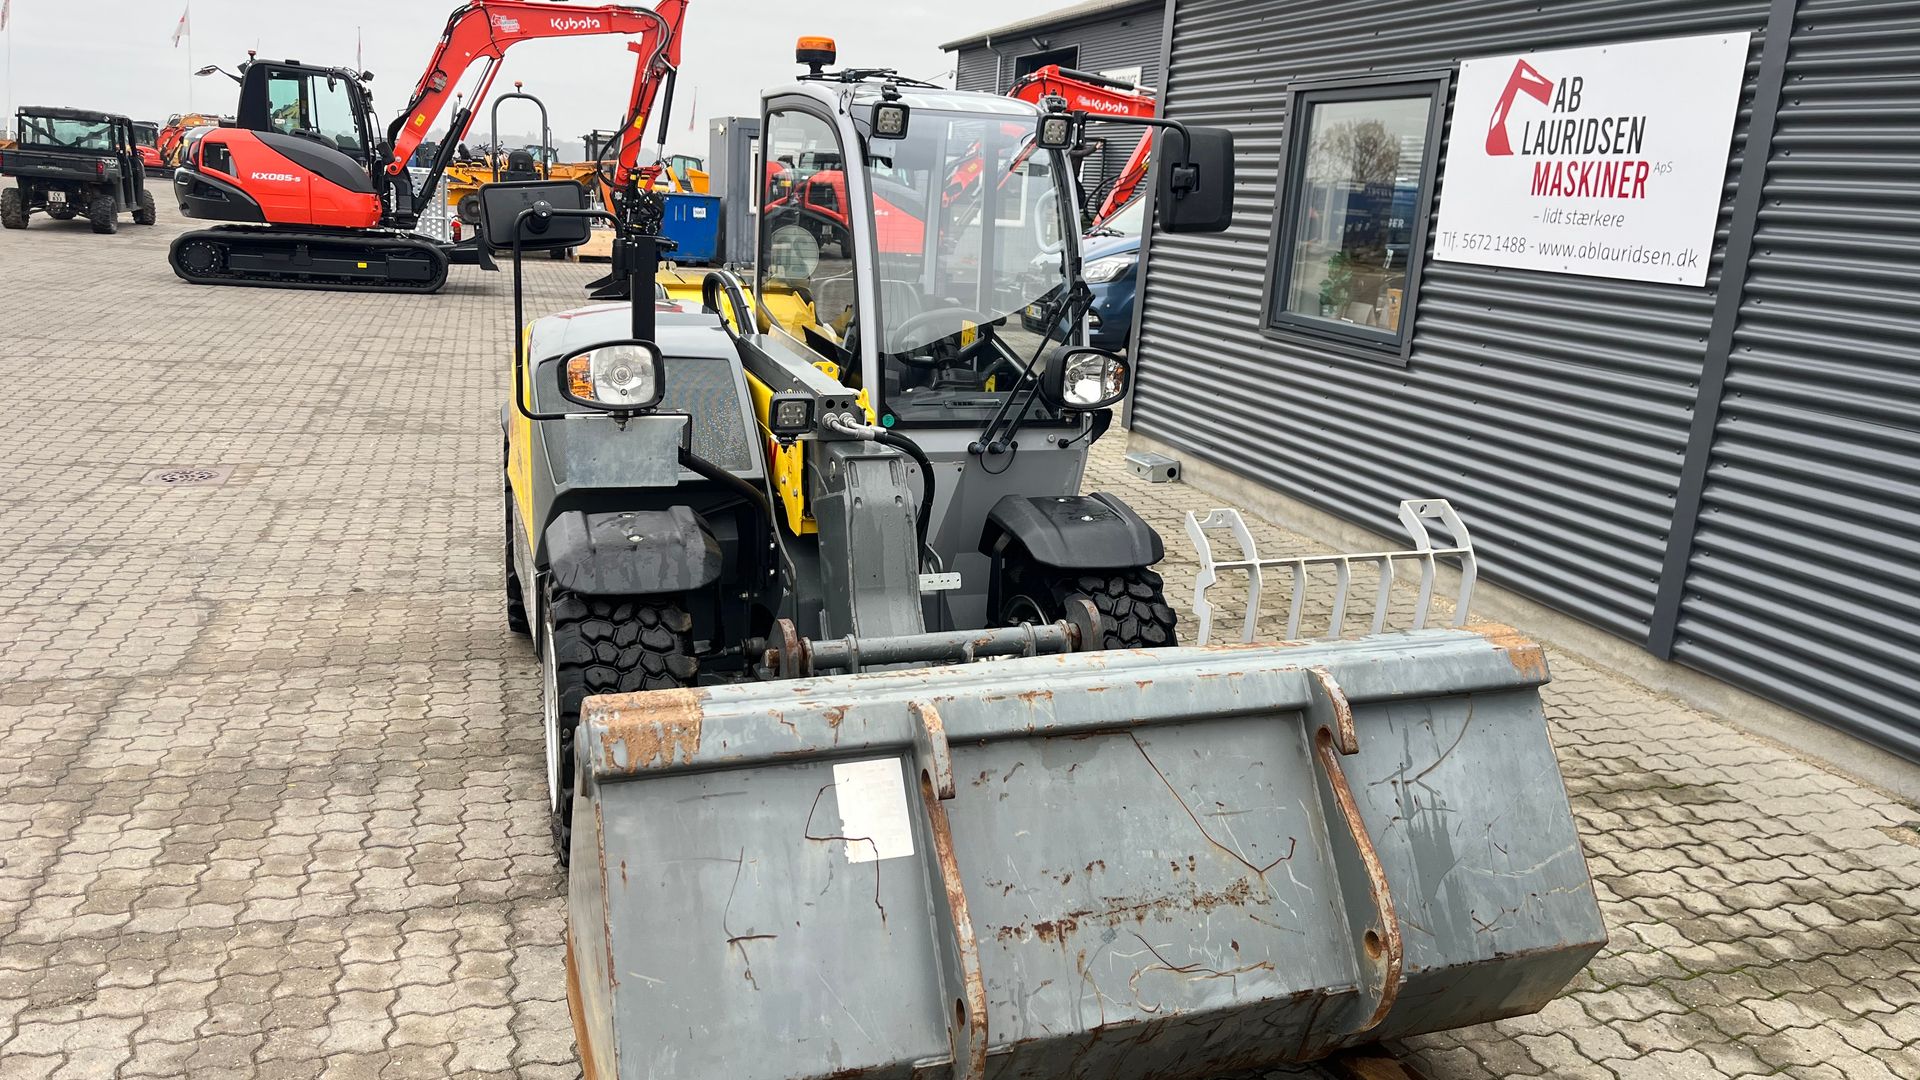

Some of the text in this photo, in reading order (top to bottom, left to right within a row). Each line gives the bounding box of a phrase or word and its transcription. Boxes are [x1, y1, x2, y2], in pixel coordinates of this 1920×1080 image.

[550, 16, 601, 31] Kubota
[1091, 99, 1129, 115] Kubota
[1552, 76, 1584, 114] AB
[1521, 115, 1647, 156] LAURIDSEN
[1530, 160, 1673, 199] MASKINER ApS
[1542, 207, 1564, 225] lidt
[1565, 209, 1625, 228] stærkere
[1442, 231, 1459, 252] Tlf.
[1538, 241, 1699, 269] www.ablauridsen.dk
